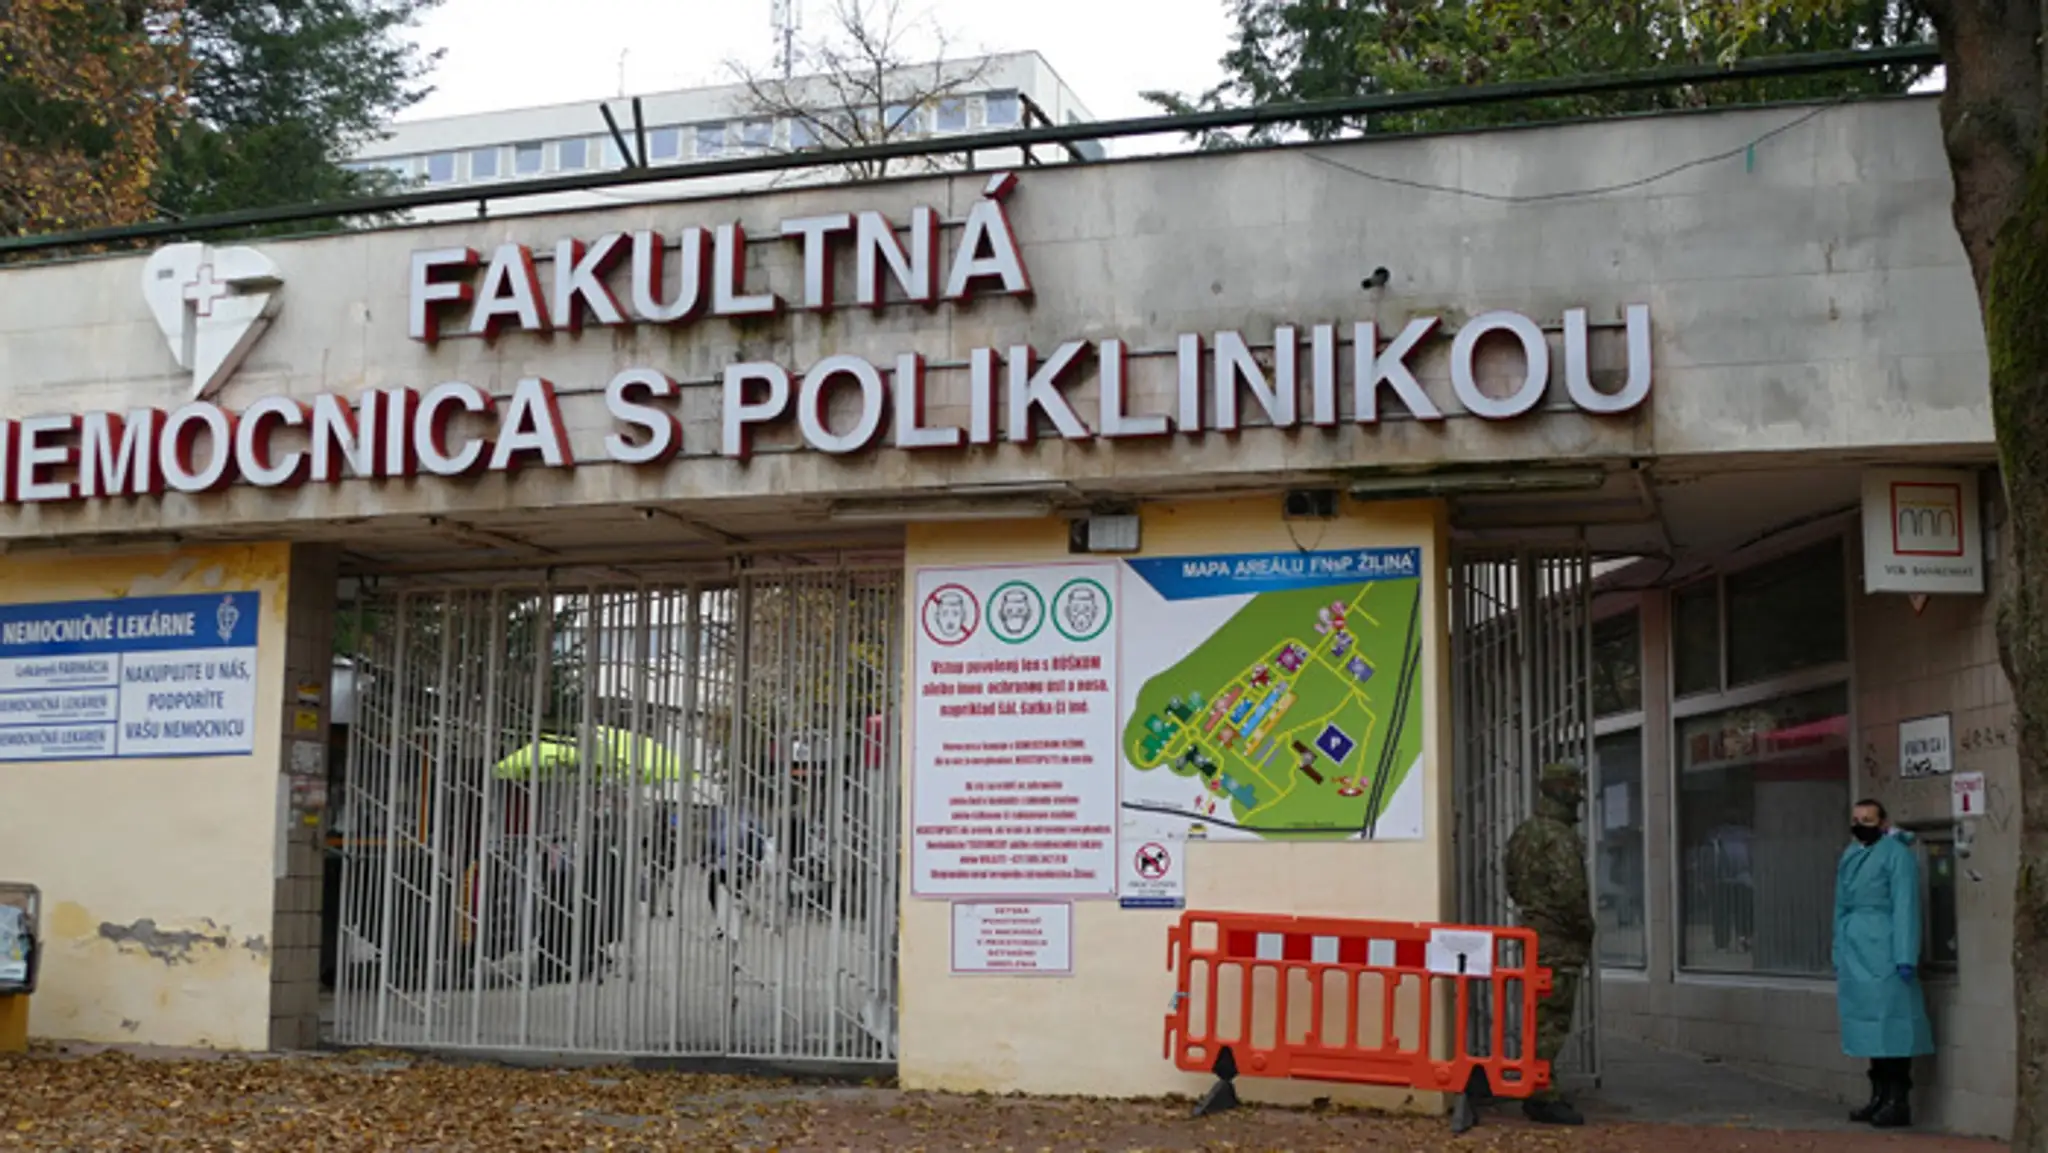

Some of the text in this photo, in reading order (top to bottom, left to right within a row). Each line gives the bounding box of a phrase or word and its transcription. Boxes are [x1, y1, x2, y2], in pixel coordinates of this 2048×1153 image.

[409, 172, 1033, 341] FAKULTNÁ
[605, 367, 681, 464] S
[722, 303, 1654, 460] POLIKLINIKOU
[1182, 560, 1231, 578] MAPA
[2, 609, 196, 645] NEMOCNIČNÉ LEKÁRNE
[205, 662, 214, 681] U
[162, 719, 244, 739] NEMOCNICU
